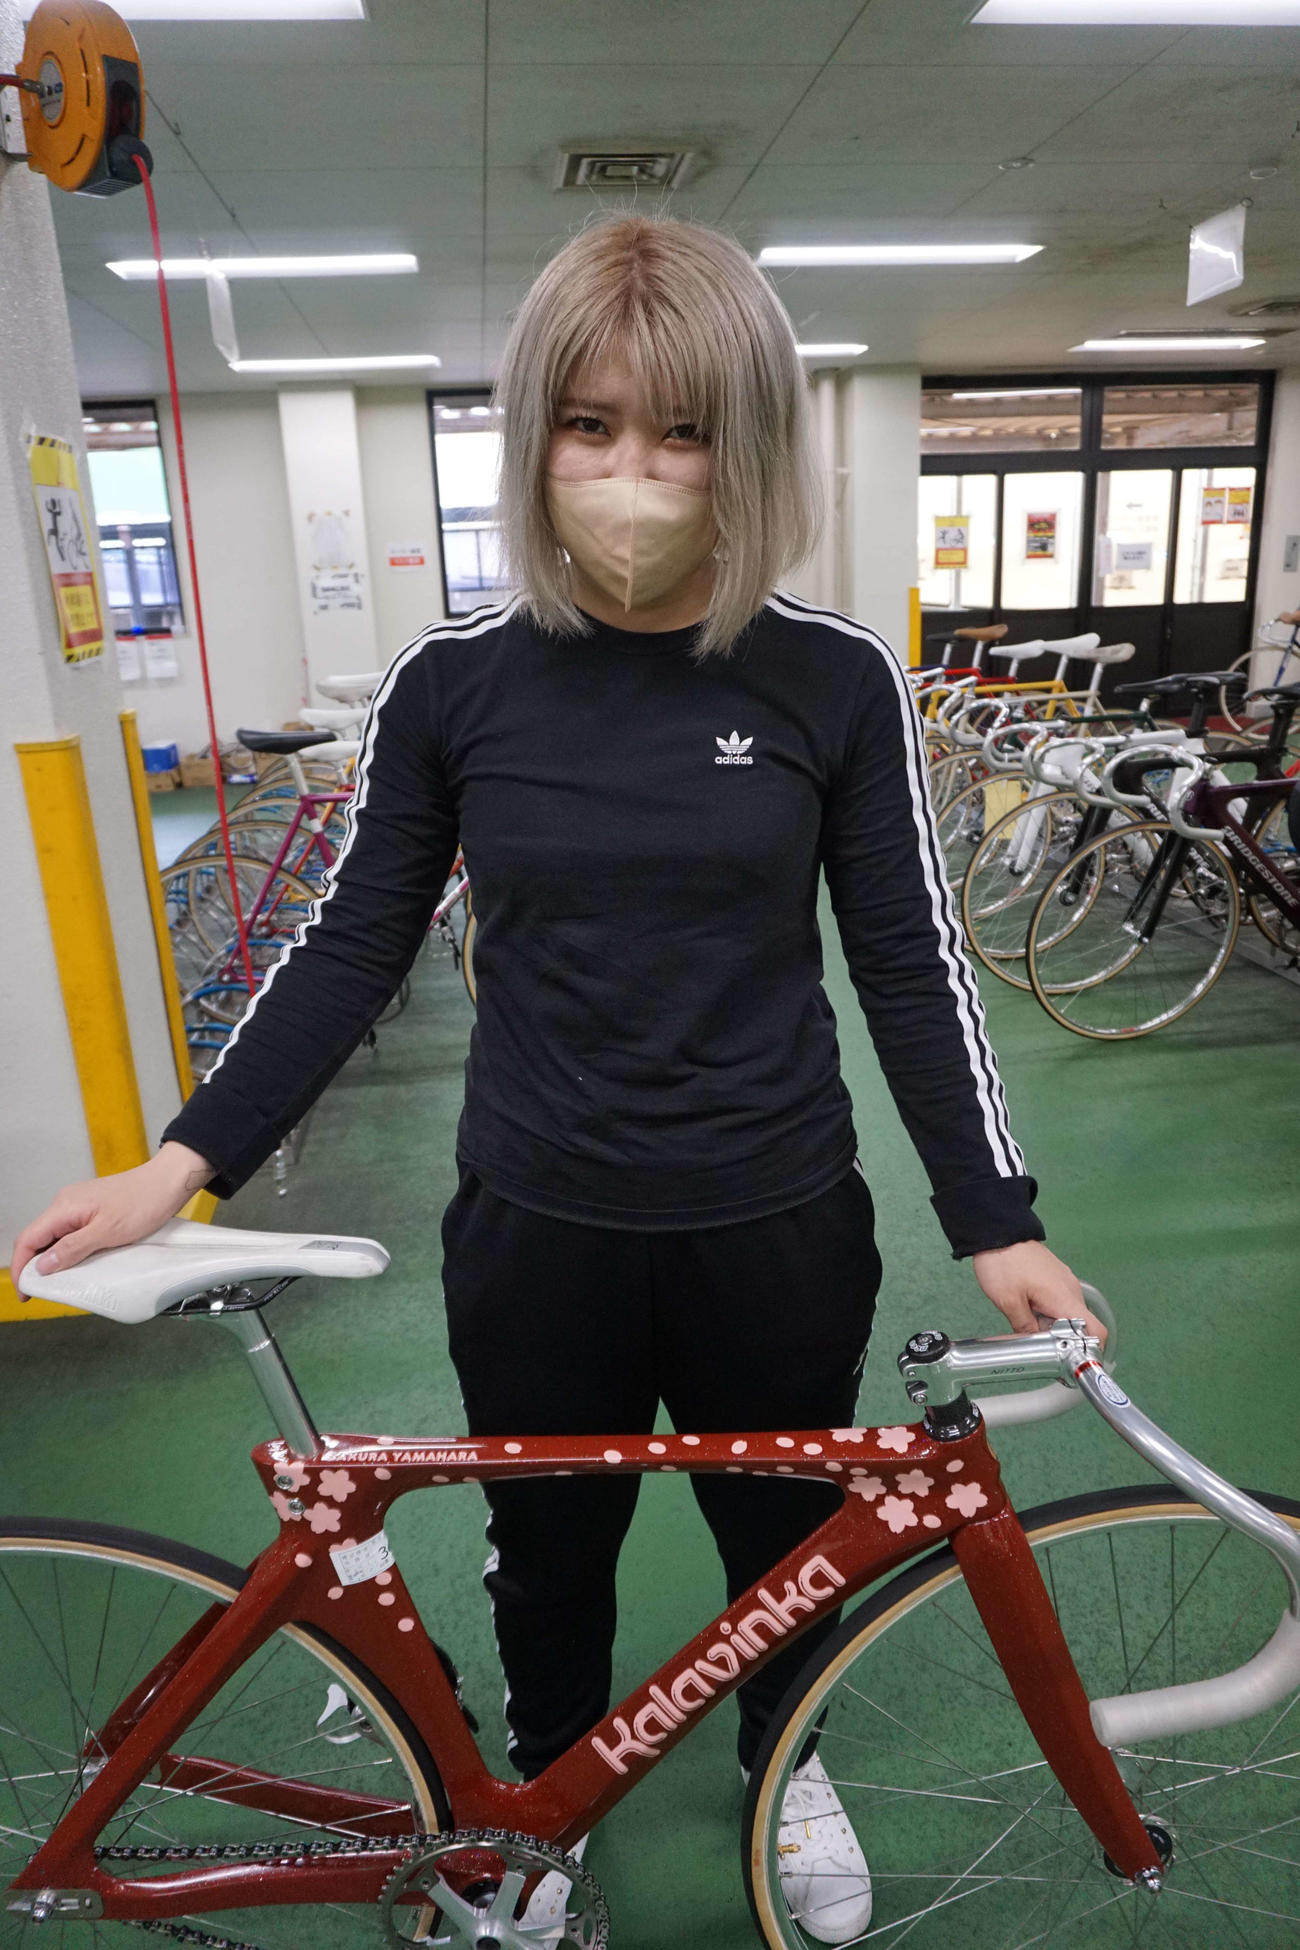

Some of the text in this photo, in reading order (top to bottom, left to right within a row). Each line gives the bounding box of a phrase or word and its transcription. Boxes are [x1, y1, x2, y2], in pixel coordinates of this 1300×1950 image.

[714, 754, 754, 765] adidas
[1223, 825, 1299, 907] BRIDGESTONE
[990, 1366, 1025, 1376] NITTO
[392, 1450, 479, 1462] YAMAHARA
[378, 1545, 389, 1561] 3
